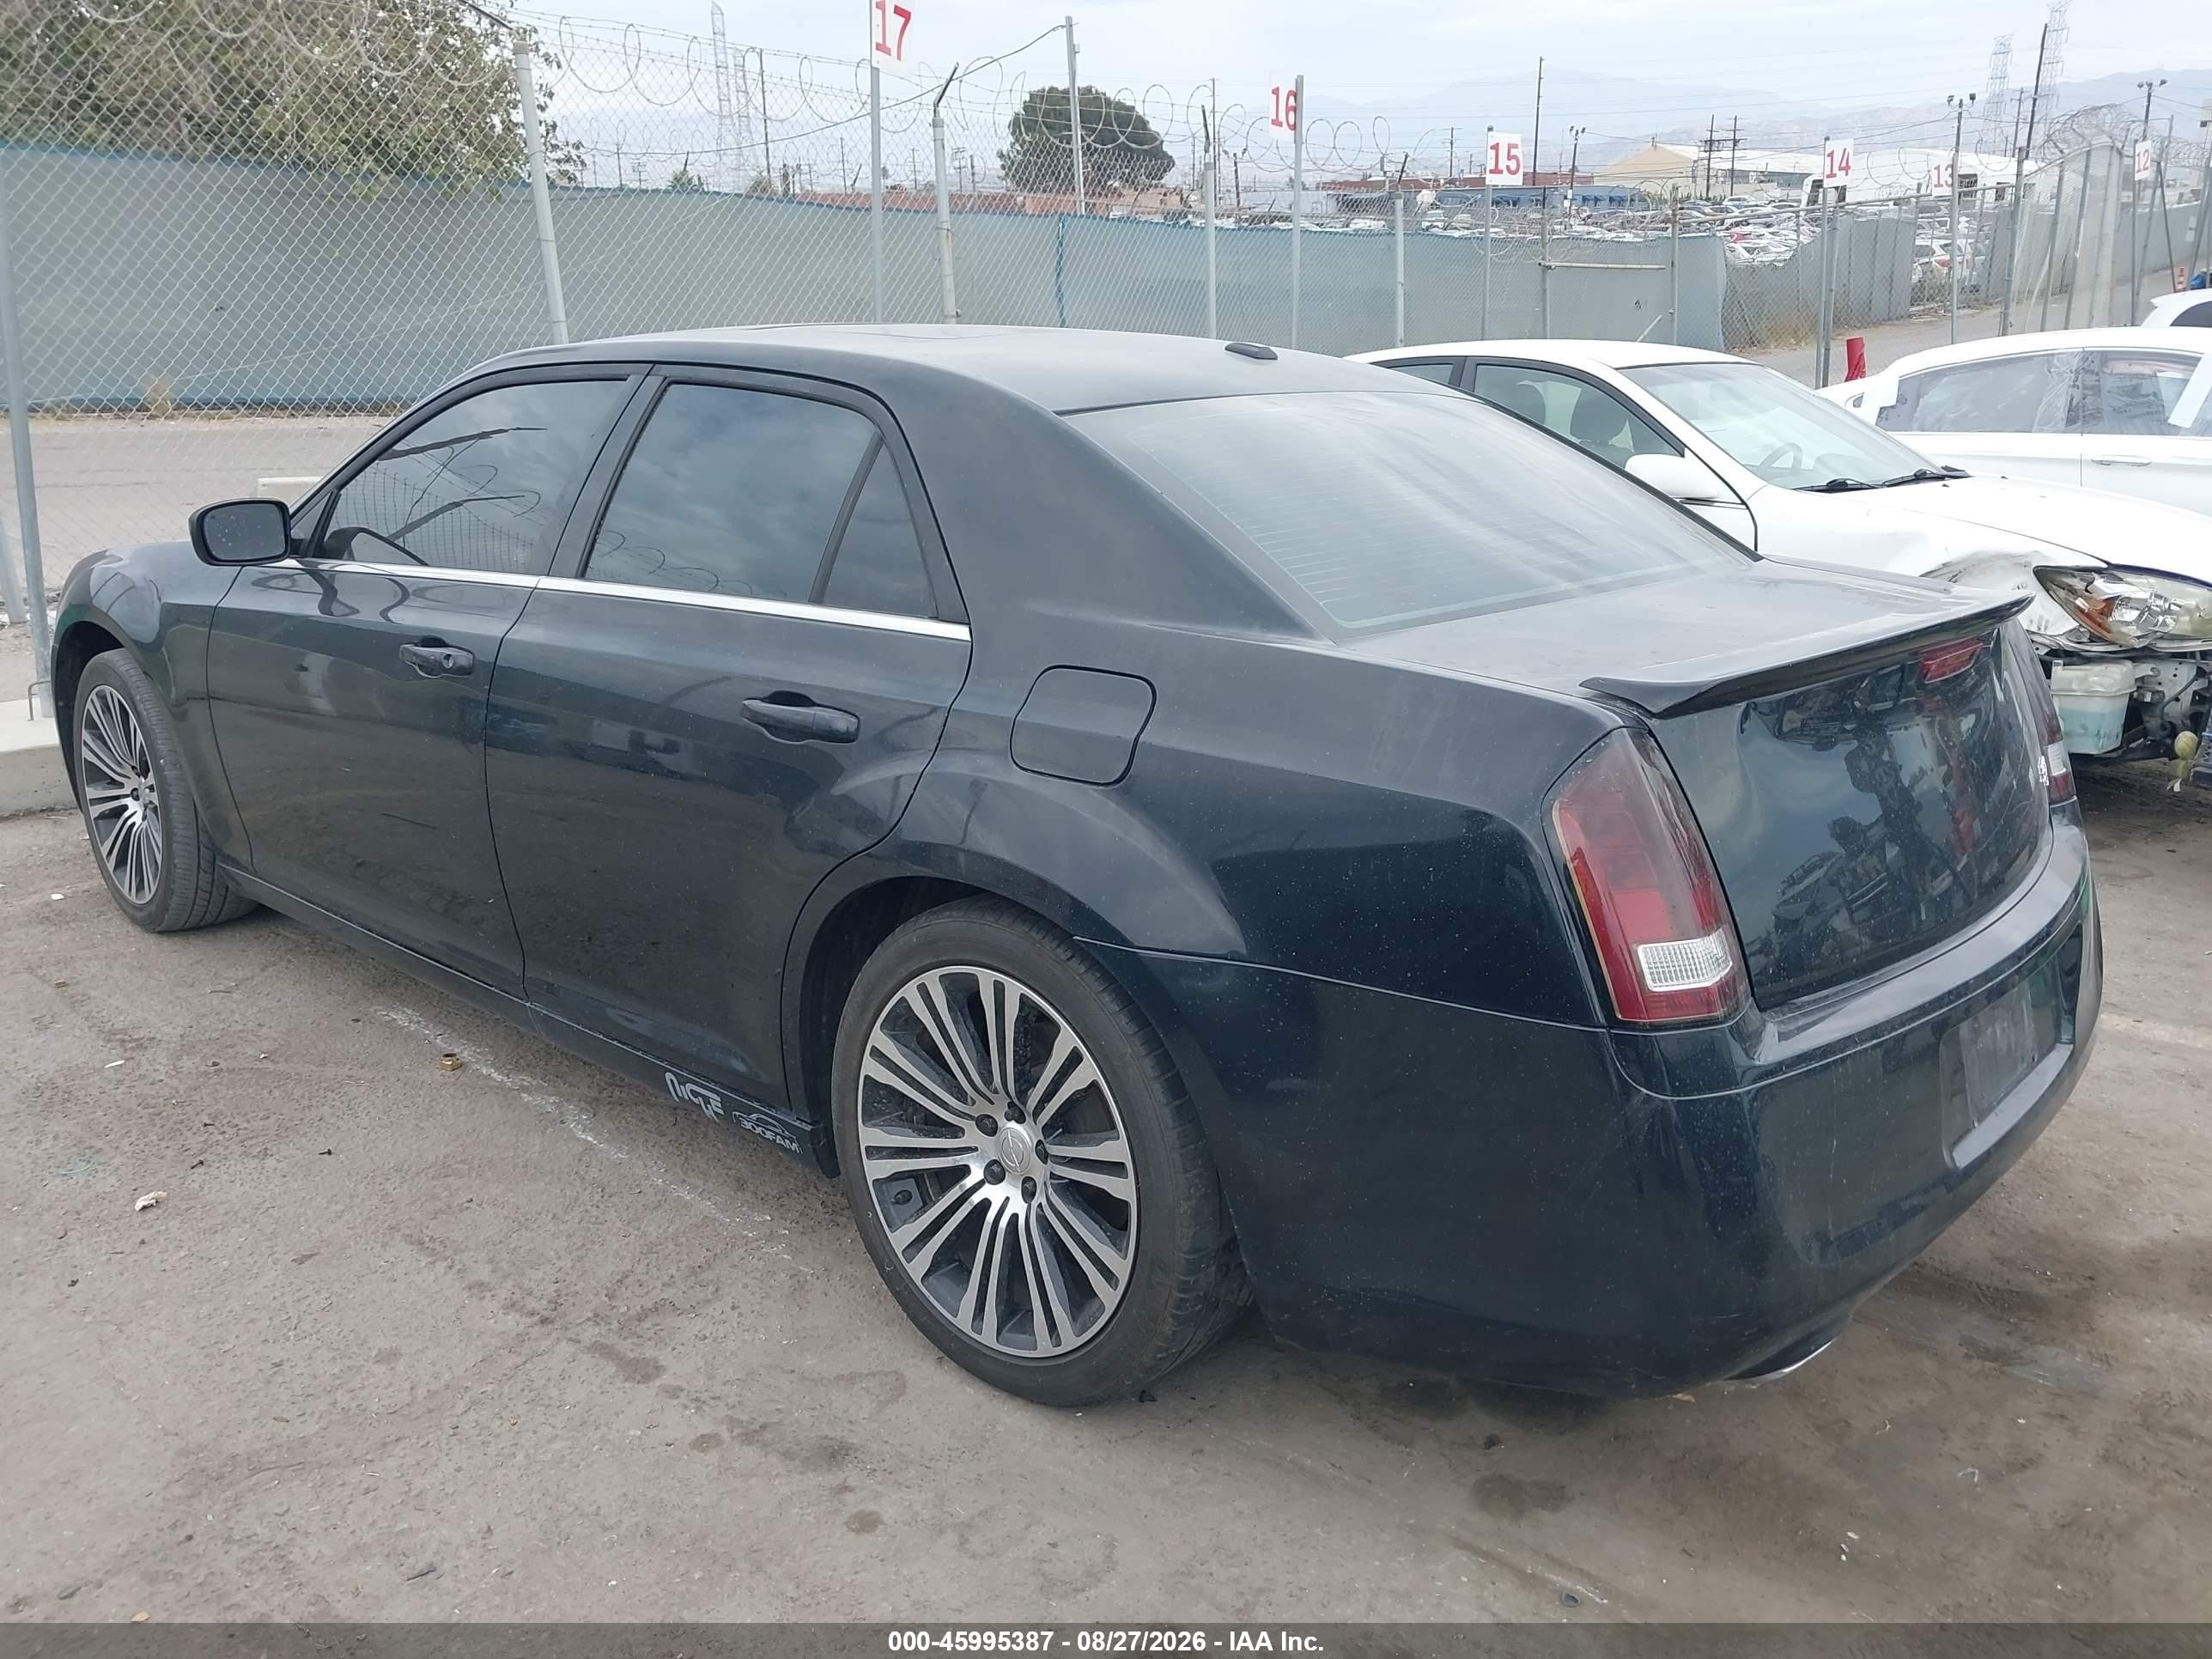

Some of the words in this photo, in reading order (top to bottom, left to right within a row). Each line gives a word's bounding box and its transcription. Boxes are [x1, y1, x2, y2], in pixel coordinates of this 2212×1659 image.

[875, 0, 912, 62] 17
[1271, 86, 1297, 131] 16
[1489, 142, 1521, 176] 15
[1826, 148, 1851, 179] 14
[2136, 149, 2149, 173] 12
[1933, 164, 1954, 188] 13
